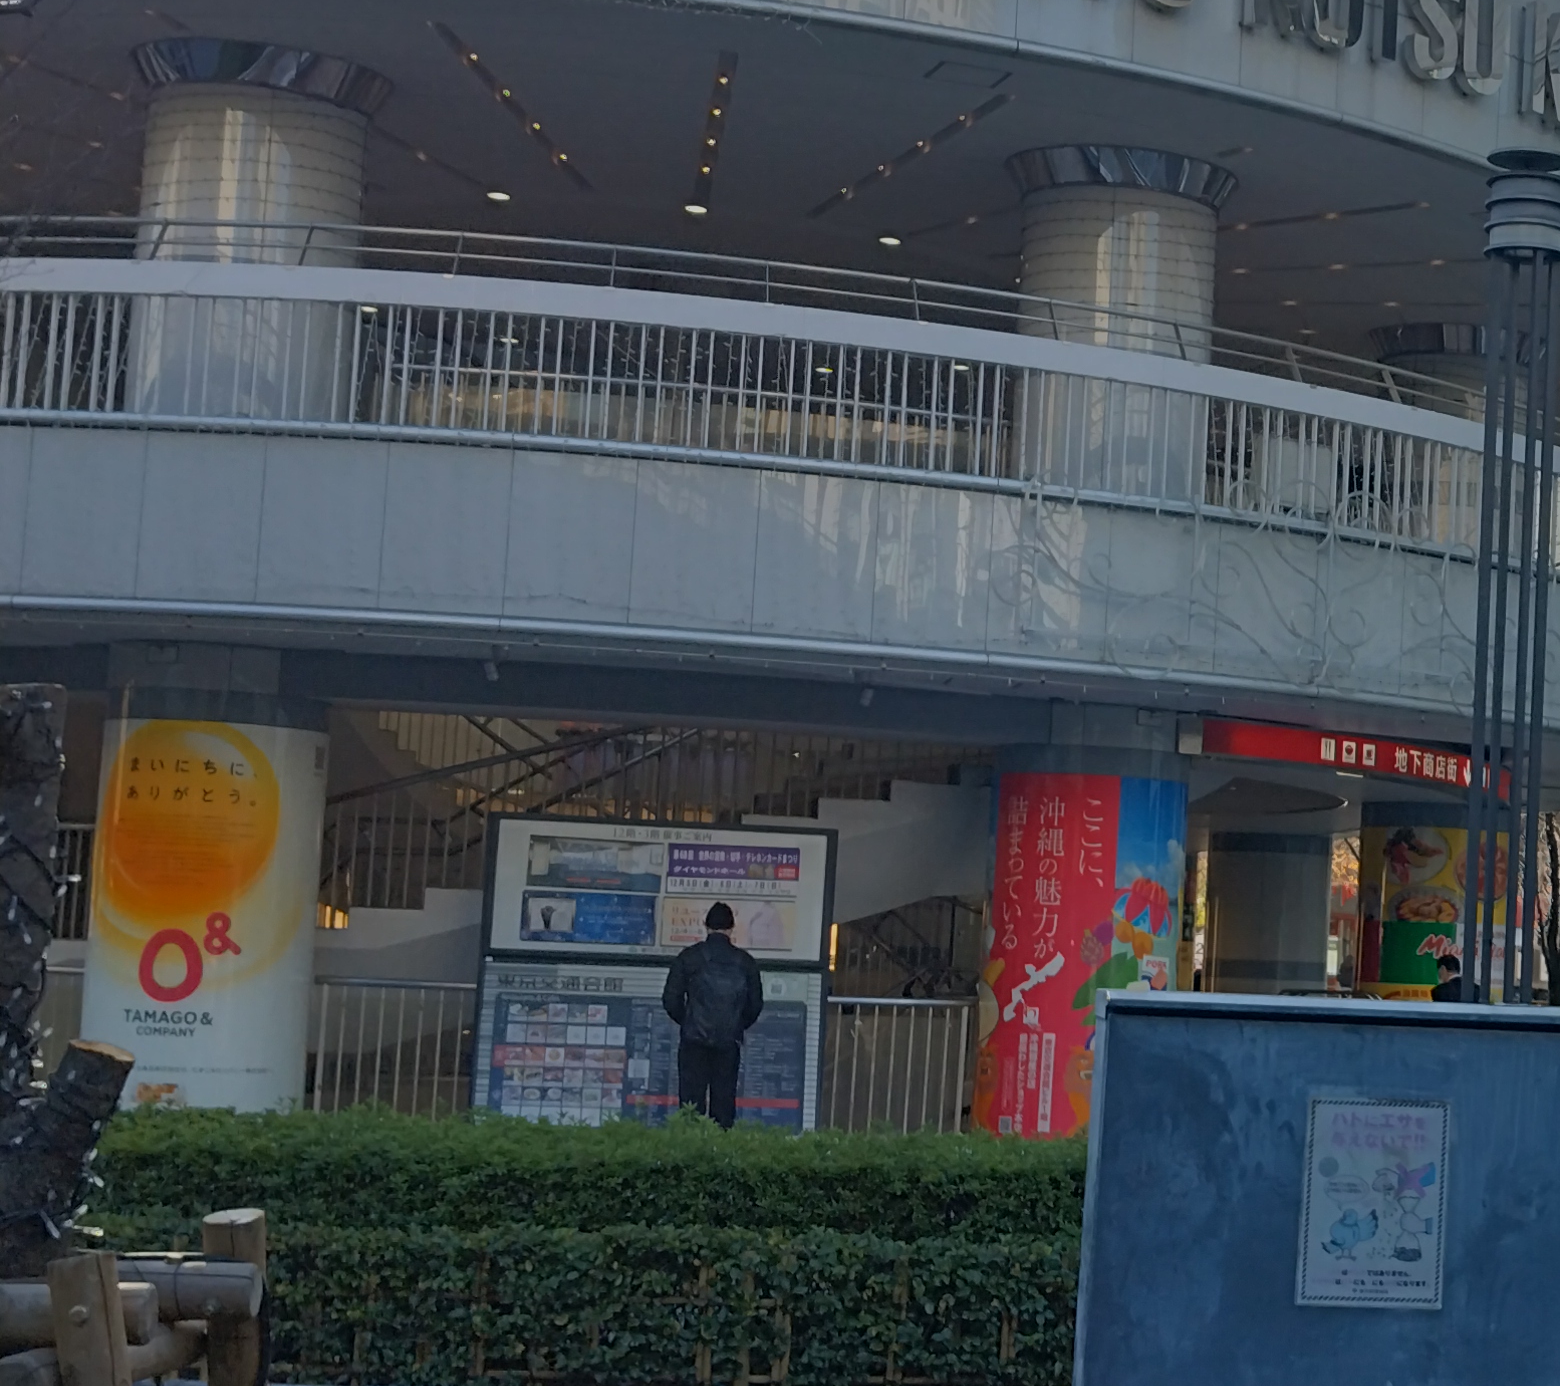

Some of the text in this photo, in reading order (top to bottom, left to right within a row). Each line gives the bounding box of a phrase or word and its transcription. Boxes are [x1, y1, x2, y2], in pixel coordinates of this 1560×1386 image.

[130, 757, 258, 778] まいにちに、
[1394, 746, 1458, 782] 地下商店街
[127, 785, 256, 807] ありがとう。
[1079, 797, 1104, 888] ここに、
[1001, 796, 1029, 950] 詰まっている
[1032, 796, 1066, 960] 沖縄の魅力が
[499, 974, 624, 992] 東京交通会館
[124, 1009, 213, 1025] TAMAGO &
[136, 1025, 195, 1037] COMPANY
